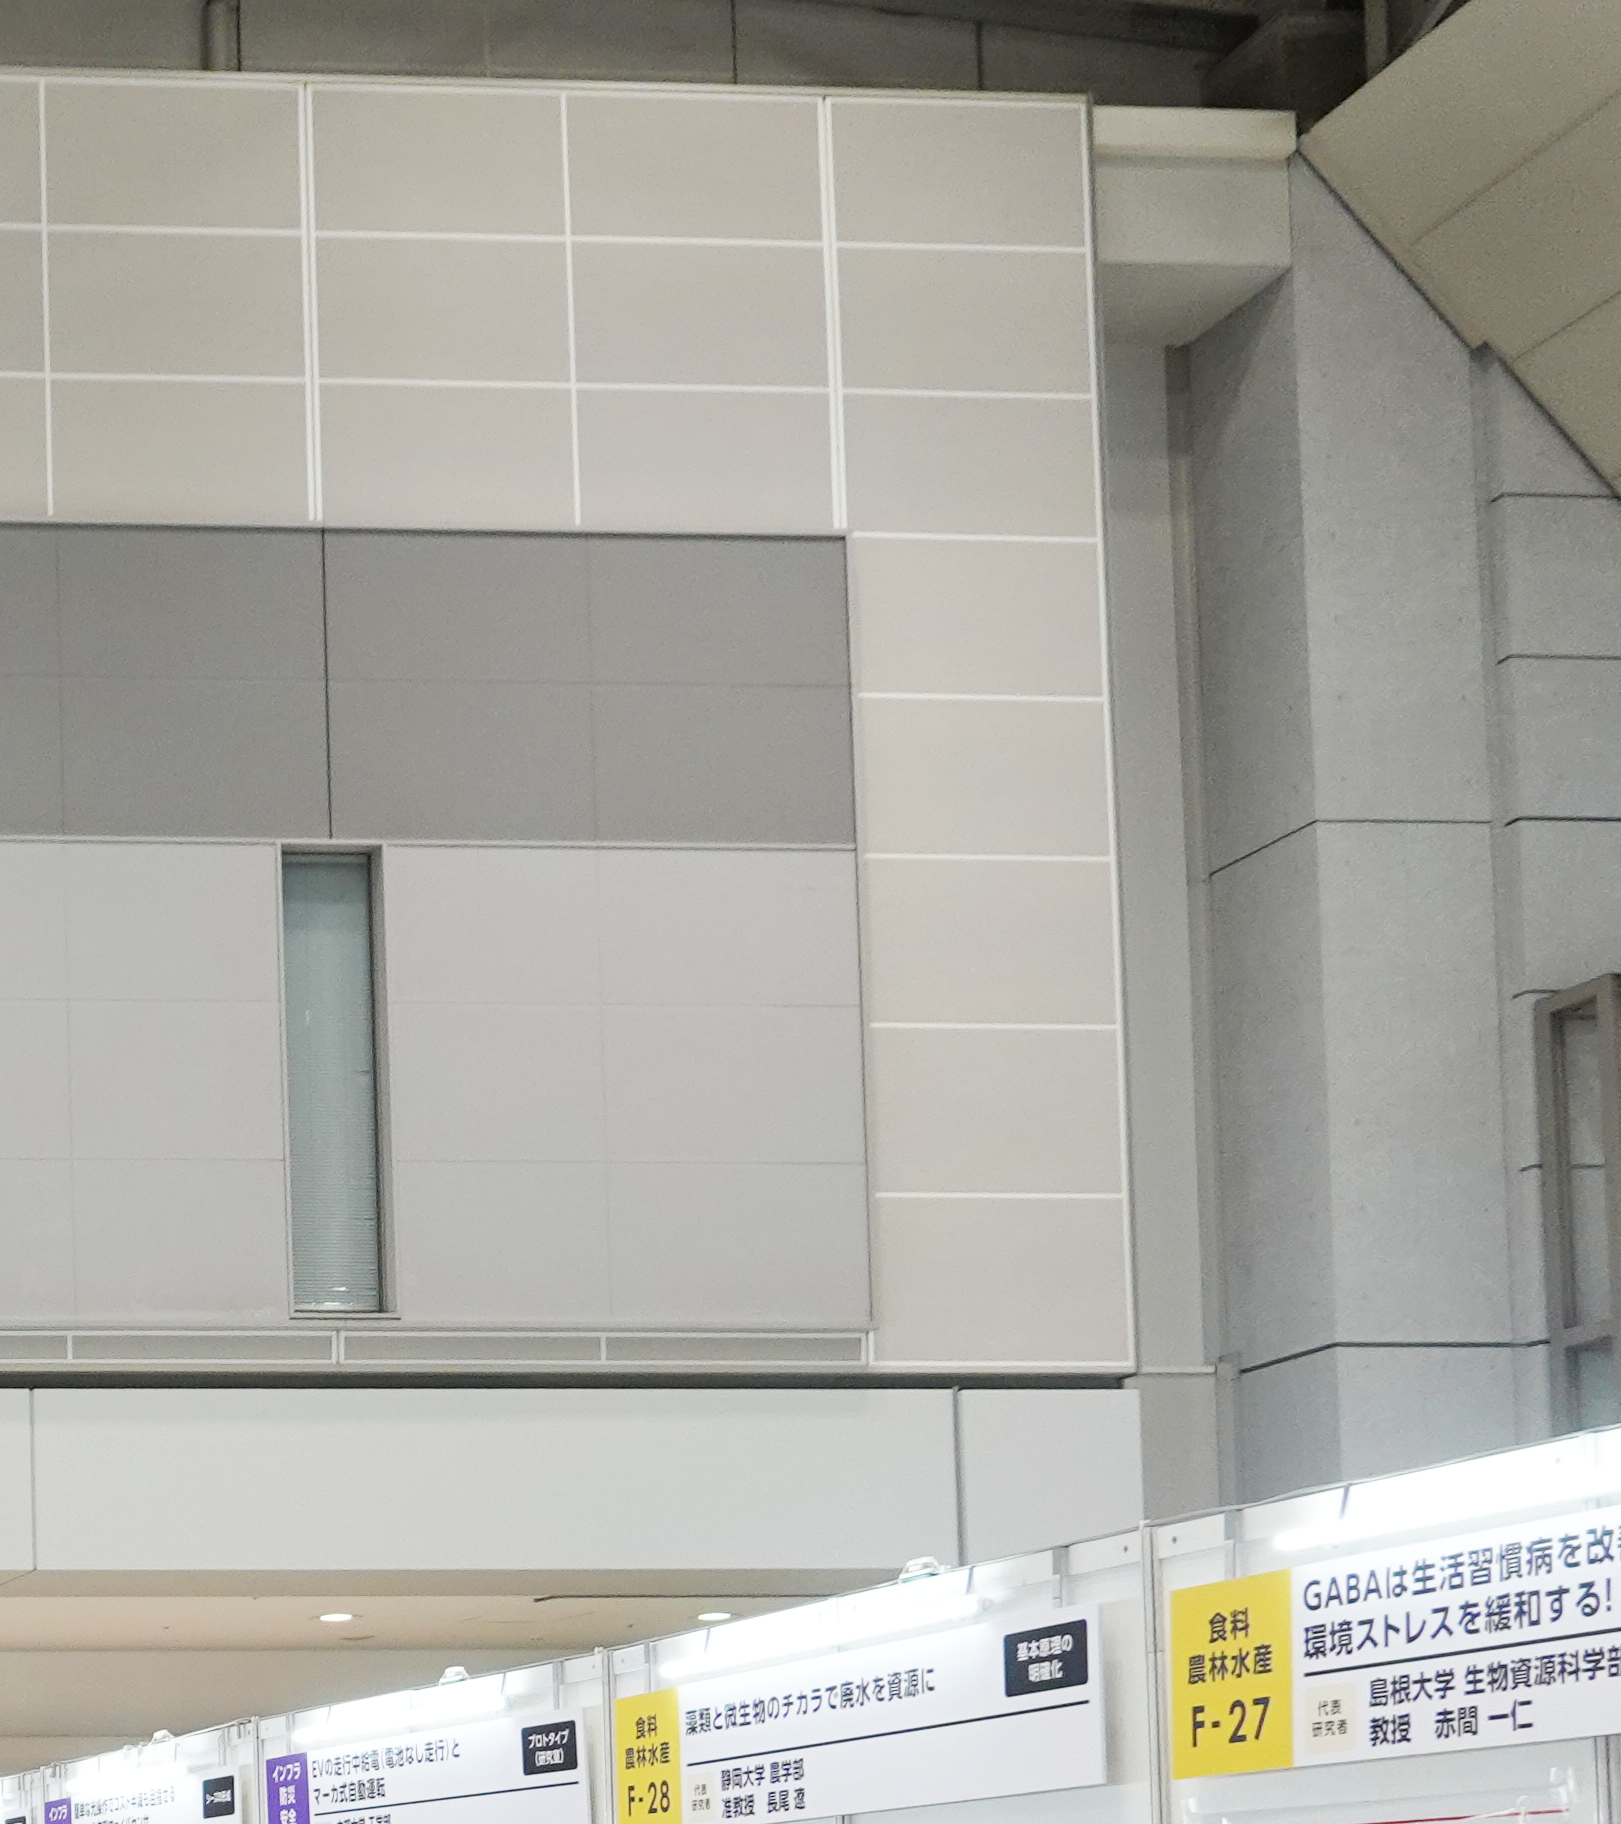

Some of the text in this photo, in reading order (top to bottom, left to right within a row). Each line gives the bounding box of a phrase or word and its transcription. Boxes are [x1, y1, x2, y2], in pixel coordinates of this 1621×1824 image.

[1303, 1525, 1621, 1611] GABAは生活習慣病を改
[1208, 1607, 1250, 1644] 食料
[1188, 1644, 1273, 1685] 農林水産
[1369, 1668, 1455, 1708] 島根大学
[635, 1714, 658, 1739] 食料
[1192, 1696, 1271, 1747] F-27
[1369, 1700, 1534, 1747] 教授 赤間 一仁
[528, 1730, 570, 1749] プロトタイプ
[625, 1742, 671, 1770] 農林水産
[272, 1762, 302, 1784] インフラ
[721, 1766, 766, 1790] 静岡大学
[48, 1804, 69, 1821] インフラ
[627, 1781, 670, 1816] F-28
